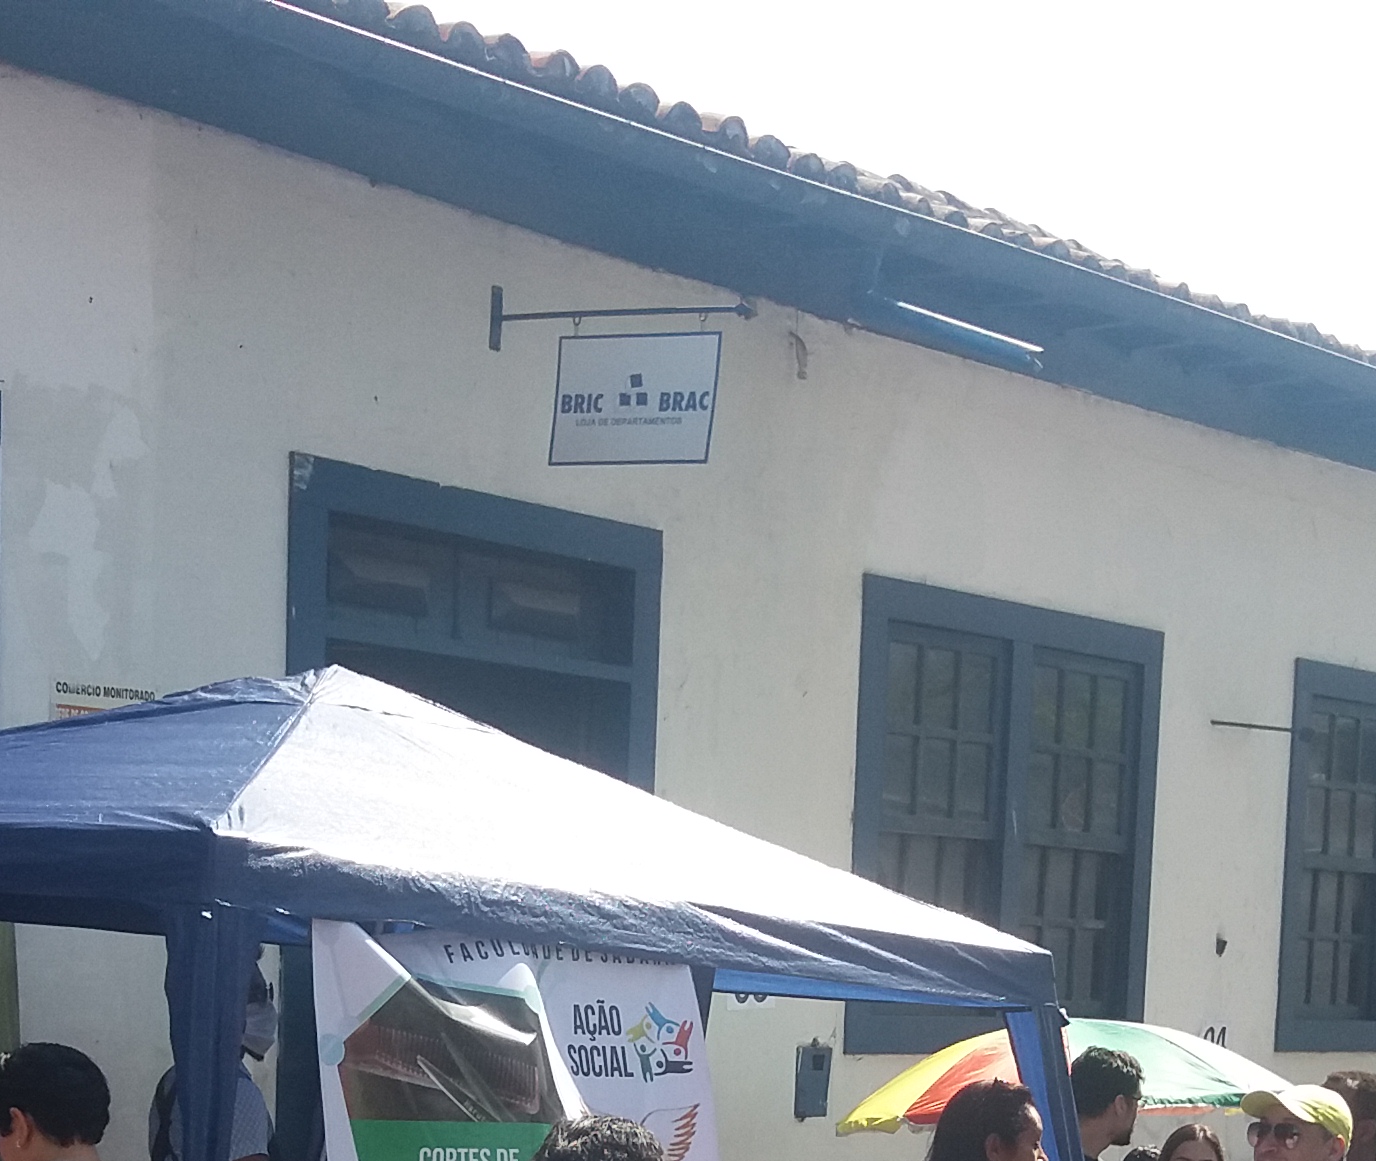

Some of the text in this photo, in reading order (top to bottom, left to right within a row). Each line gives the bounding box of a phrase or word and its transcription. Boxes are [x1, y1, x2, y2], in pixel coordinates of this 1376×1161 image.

[560, 391, 710, 414] BRIC BRAC
[575, 417, 683, 427] LOJA DE DEPARTAMENTOS
[103, 686, 156, 701] MONITORADO
[573, 999, 622, 1041] AÇÃO
[567, 1044, 635, 1078] SOCIAL
